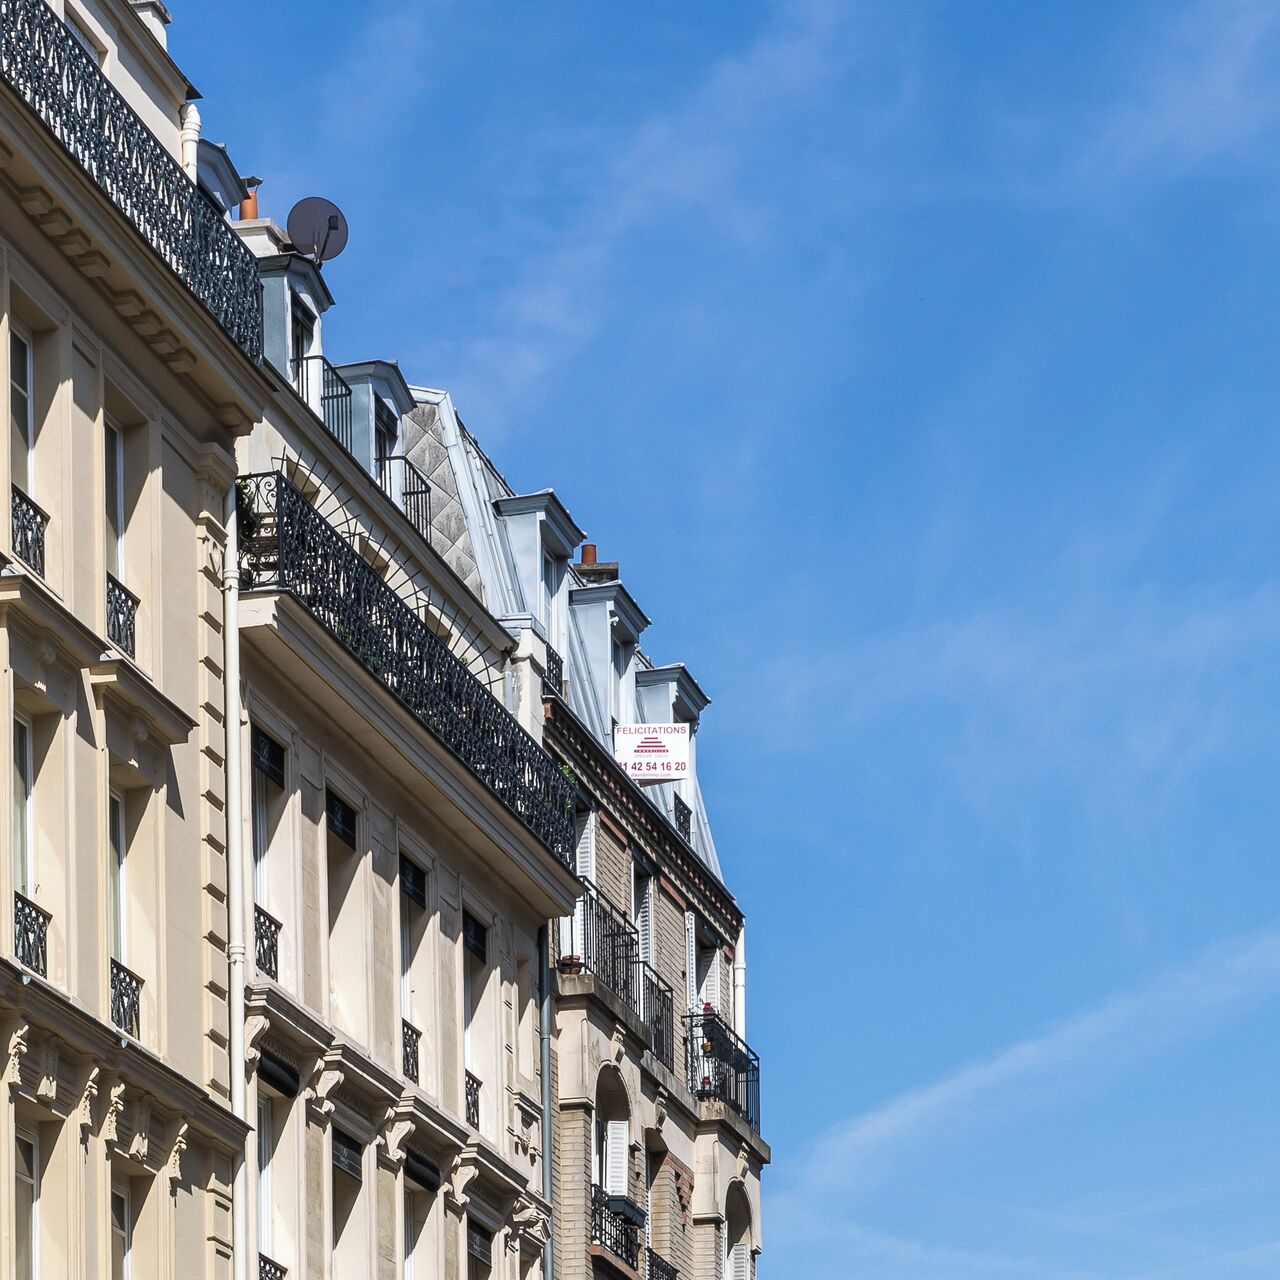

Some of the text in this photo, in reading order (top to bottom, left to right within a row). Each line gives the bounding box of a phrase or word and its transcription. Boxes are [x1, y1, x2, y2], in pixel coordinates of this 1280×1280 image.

[631, 762, 643, 771] 42
[646, 762, 657, 771] 54
[661, 762, 672, 771] 16
[674, 762, 686, 771] 20
